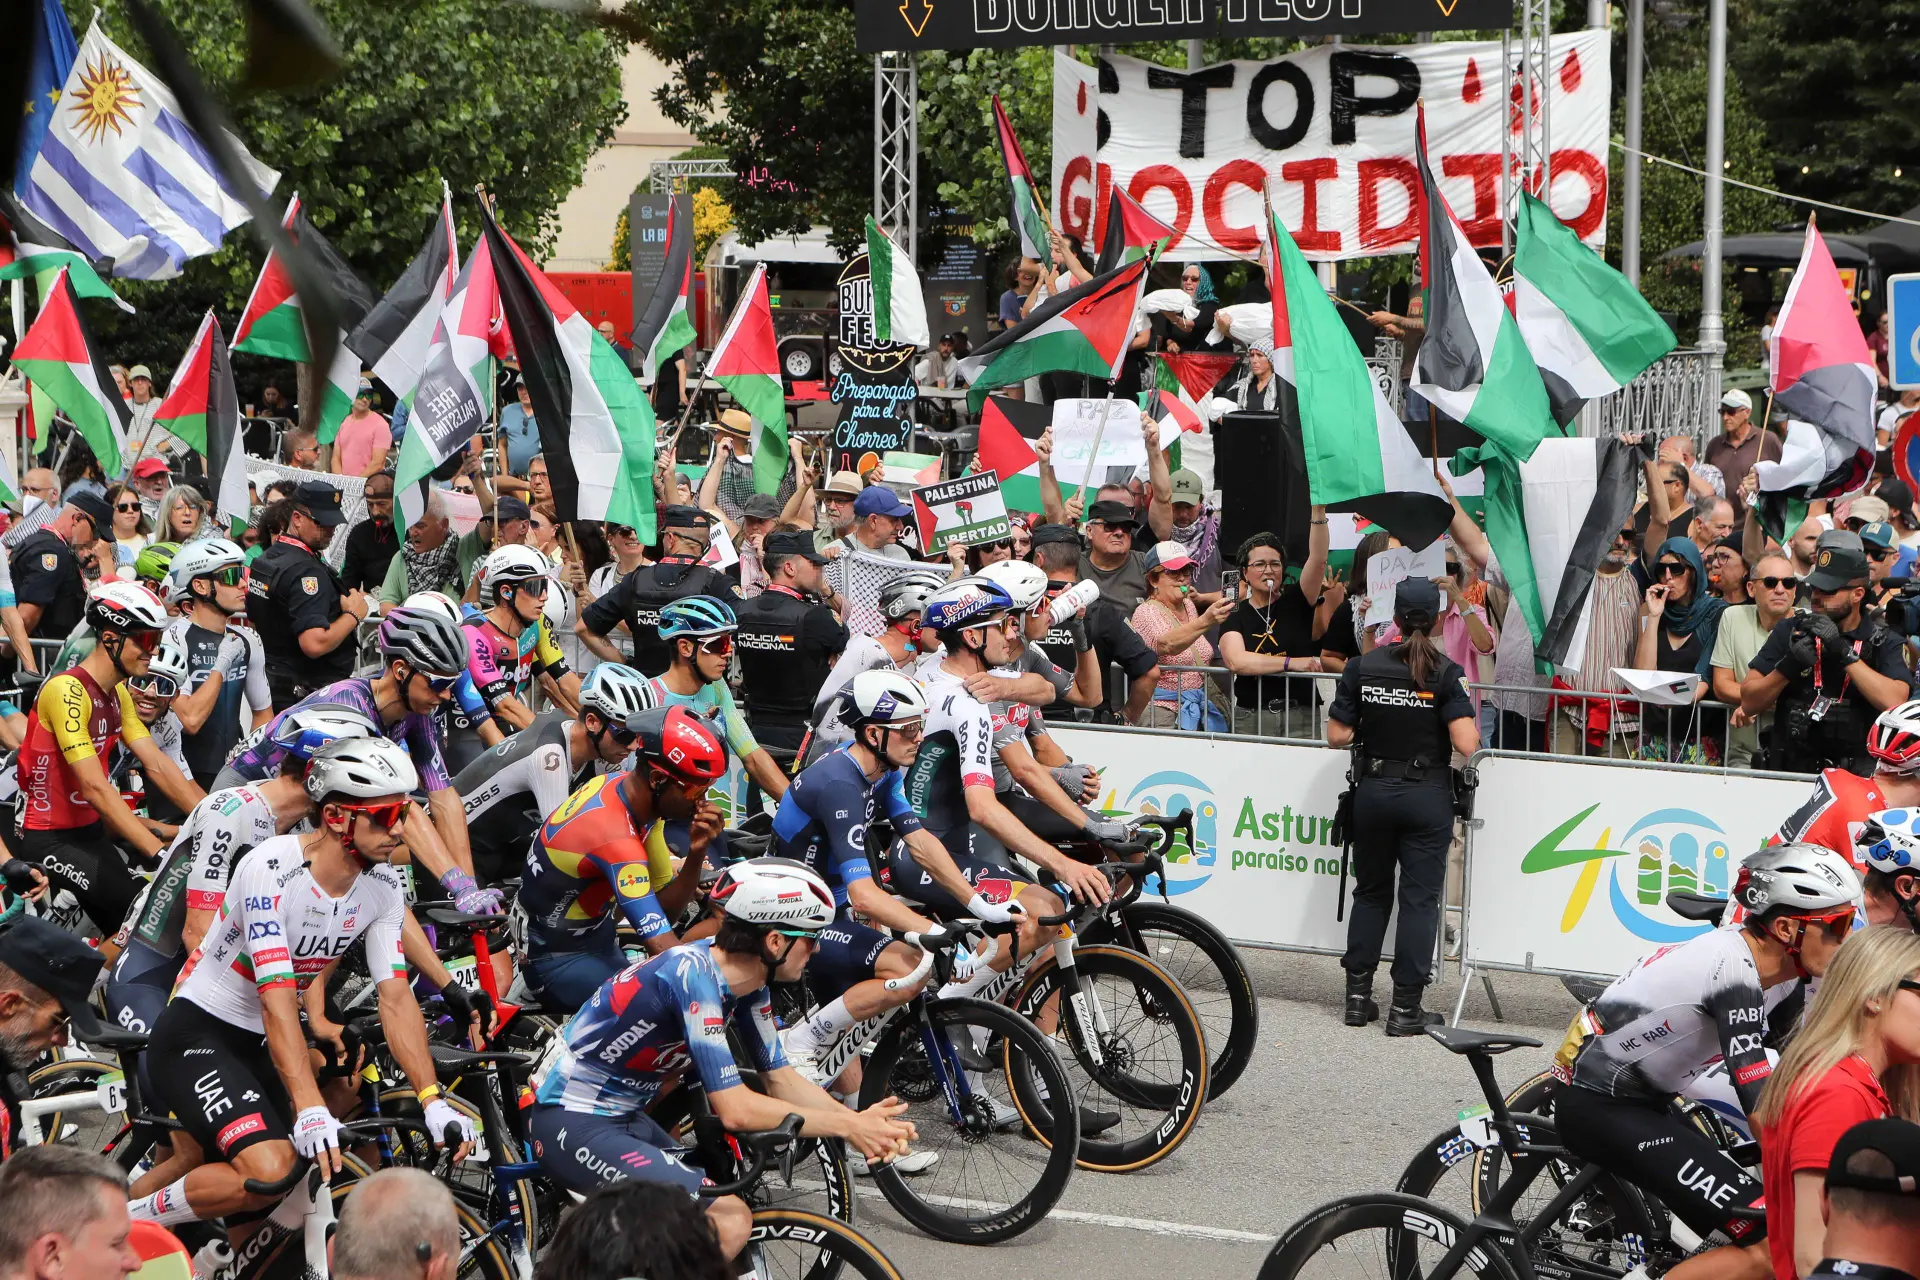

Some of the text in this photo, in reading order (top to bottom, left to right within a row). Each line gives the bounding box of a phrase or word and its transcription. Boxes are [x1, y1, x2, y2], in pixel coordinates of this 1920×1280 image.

[851, 400, 894, 423] para el
[1076, 400, 1129, 420] PAZ
[836, 419, 911, 450] Chorreo?
[924, 475, 997, 503] PALESTINA
[936, 522, 1008, 548] LIBERTAD
[637, 609, 662, 619] POL
[941, 598, 966, 618] Red
[942, 594, 993, 628] SPECIALIZED
[737, 632, 781, 644] POLICIA
[1047, 628, 1073, 637] ICIA
[411, 637, 440, 664] GIANT
[475, 638, 496, 674] lotto
[737, 640, 795, 651] NACIONAL
[1361, 685, 1419, 699] POLICIA
[1361, 694, 1434, 708] NACIONAL
[826, 717, 840, 731] IHC
[676, 721, 714, 754] TREK
[976, 717, 990, 766] BOSS
[314, 759, 334, 771] MET
[29, 754, 51, 812] Cofidis
[307, 774, 325, 793] G42
[464, 783, 501, 815] Q36.5
[1232, 795, 1336, 847] Astur
[1889, 832, 1918, 849] MET
[204, 828, 233, 881] BOSS
[1231, 846, 1309, 873] paraíso
[1875, 844, 1901, 864] G42
[43, 854, 91, 891] Cofidis
[368, 868, 399, 890] Analog
[1751, 871, 1779, 884] MET
[1814, 862, 1846, 889] MET
[138, 860, 193, 938] hansgrohe
[777, 897, 803, 905] SOUDAL
[1746, 887, 1770, 905] G42
[748, 903, 822, 921] SPECIALIZED
[249, 920, 281, 942] ADQ
[636, 917, 670, 936] CRIVIT
[293, 935, 352, 957] UAE
[1021, 975, 1051, 1016] val
[600, 1018, 658, 1065] SOUDAL
[1618, 1037, 1642, 1053] IHC
[1739, 1063, 1771, 1081] Emirates
[109, 1085, 118, 1109] 6
[194, 1069, 234, 1124] UAE
[1155, 1067, 1195, 1146] roval
[1647, 1136, 1674, 1148] PISSEI
[575, 1146, 629, 1184] QUICK
[1676, 1157, 1740, 1210] UAE
[1499, 1237, 1515, 1246] UAE
